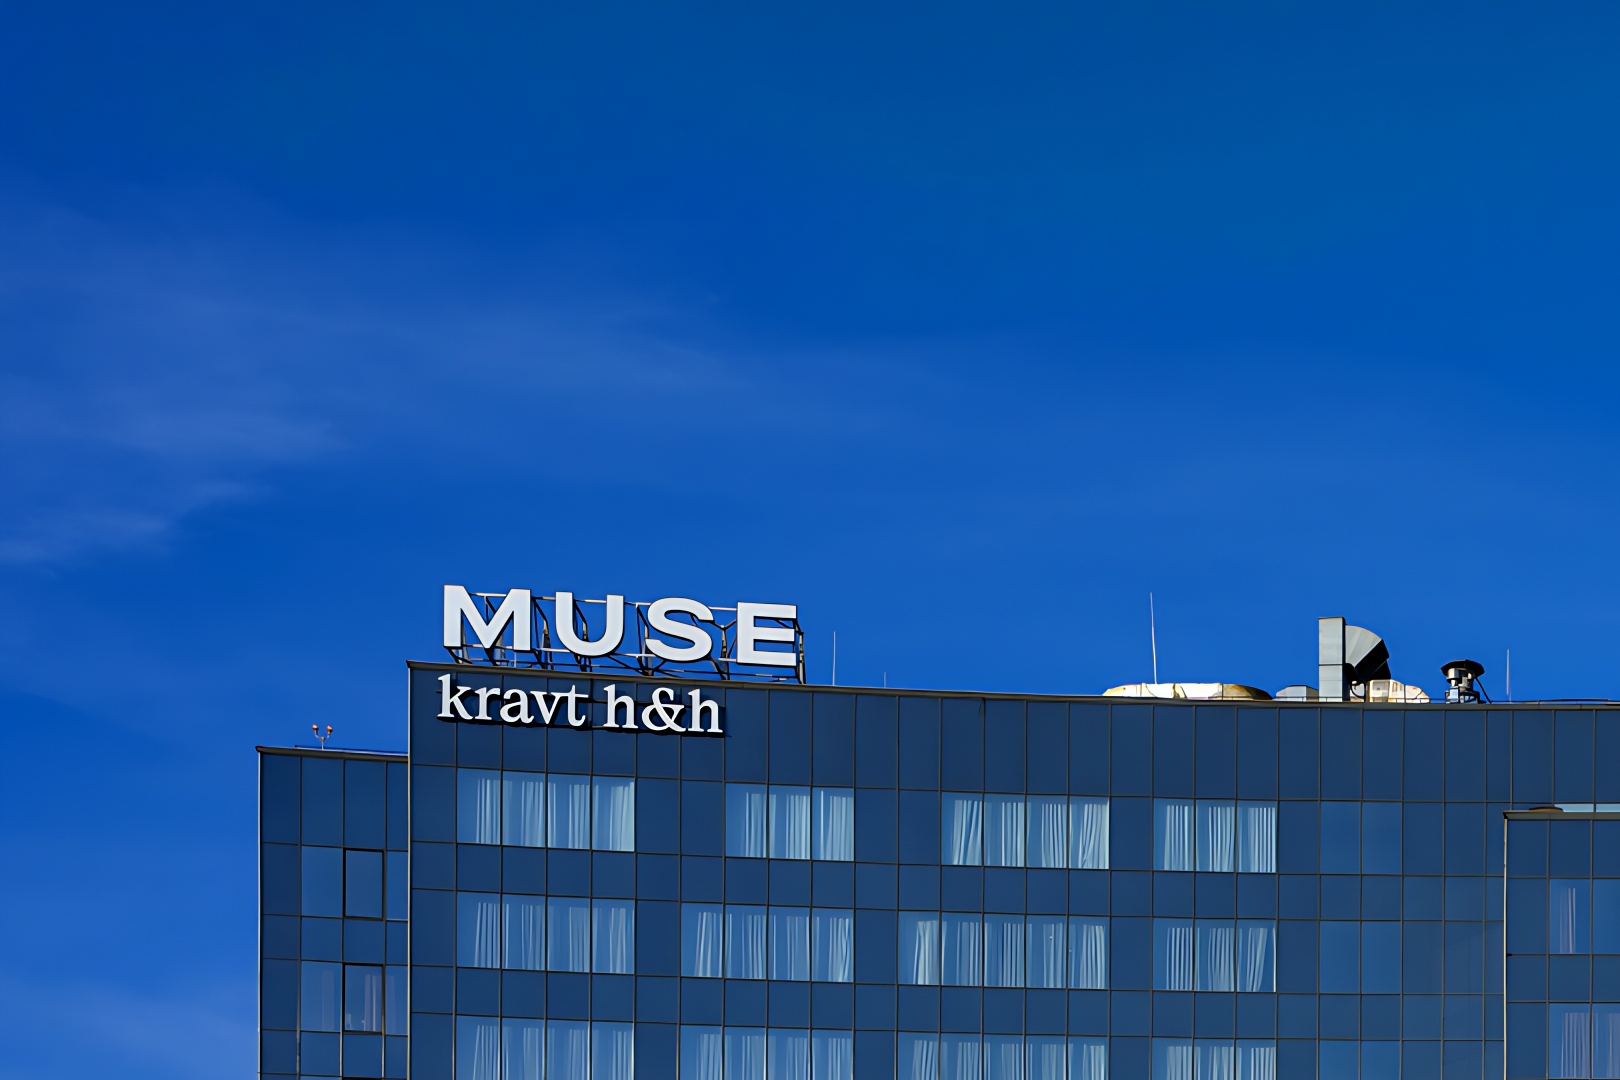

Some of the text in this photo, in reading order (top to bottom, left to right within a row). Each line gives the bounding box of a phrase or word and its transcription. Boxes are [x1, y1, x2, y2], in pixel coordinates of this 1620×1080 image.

[443, 584, 798, 667] MUSE
[437, 674, 724, 733] kravt h&h
